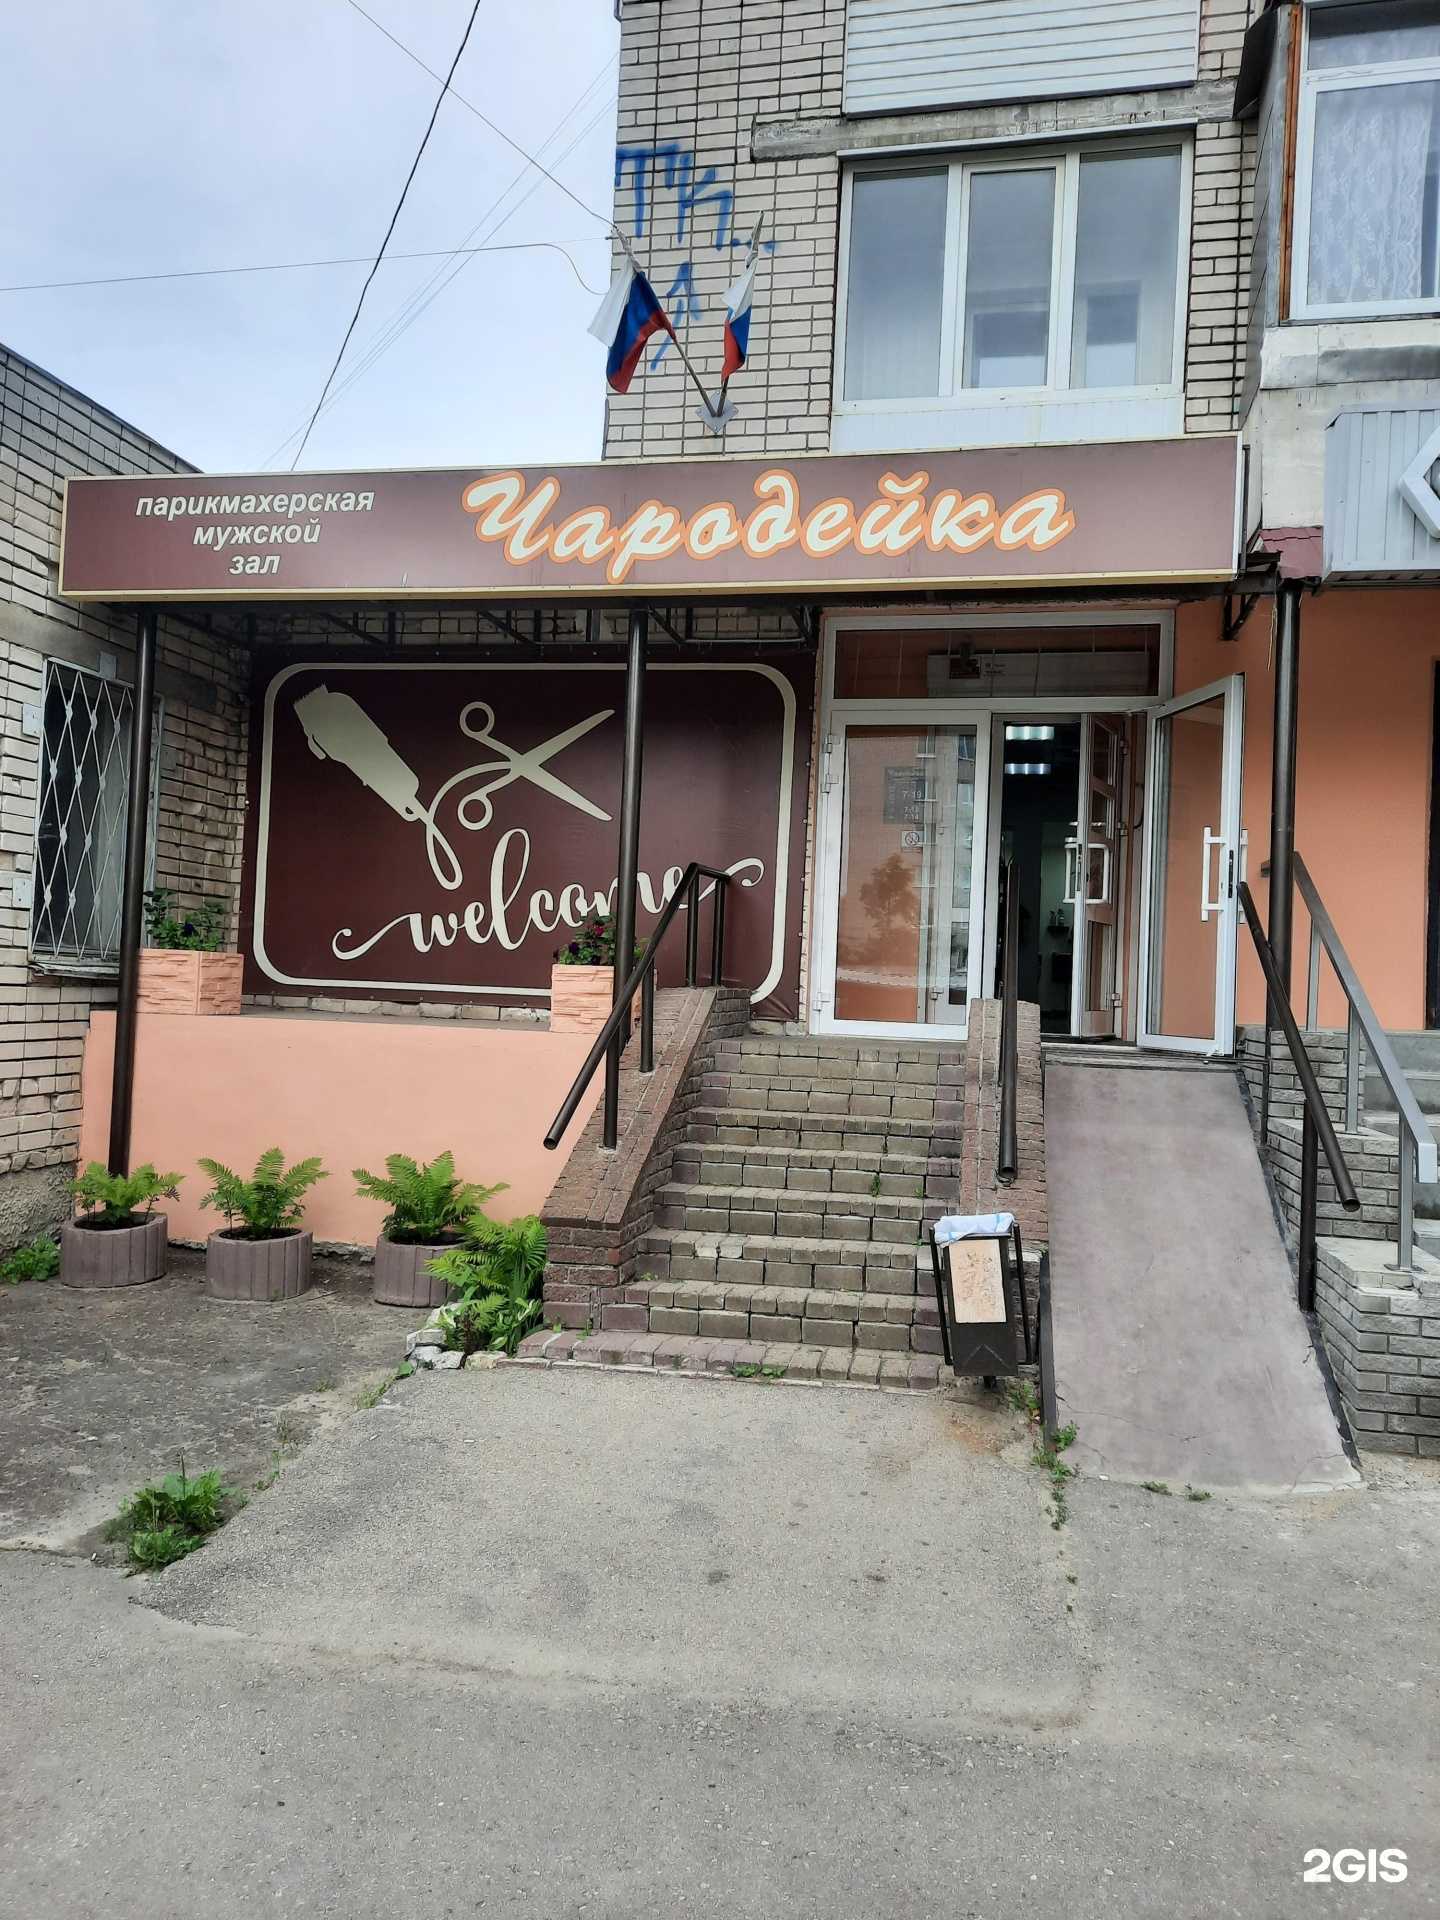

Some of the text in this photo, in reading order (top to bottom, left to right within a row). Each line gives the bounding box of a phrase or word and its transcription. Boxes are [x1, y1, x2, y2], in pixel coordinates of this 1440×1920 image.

[135, 490, 375, 522] парикмахерская
[192, 517, 322, 552] мужской
[463, 469, 1074, 585] Чародейка
[228, 554, 281, 575] зал
